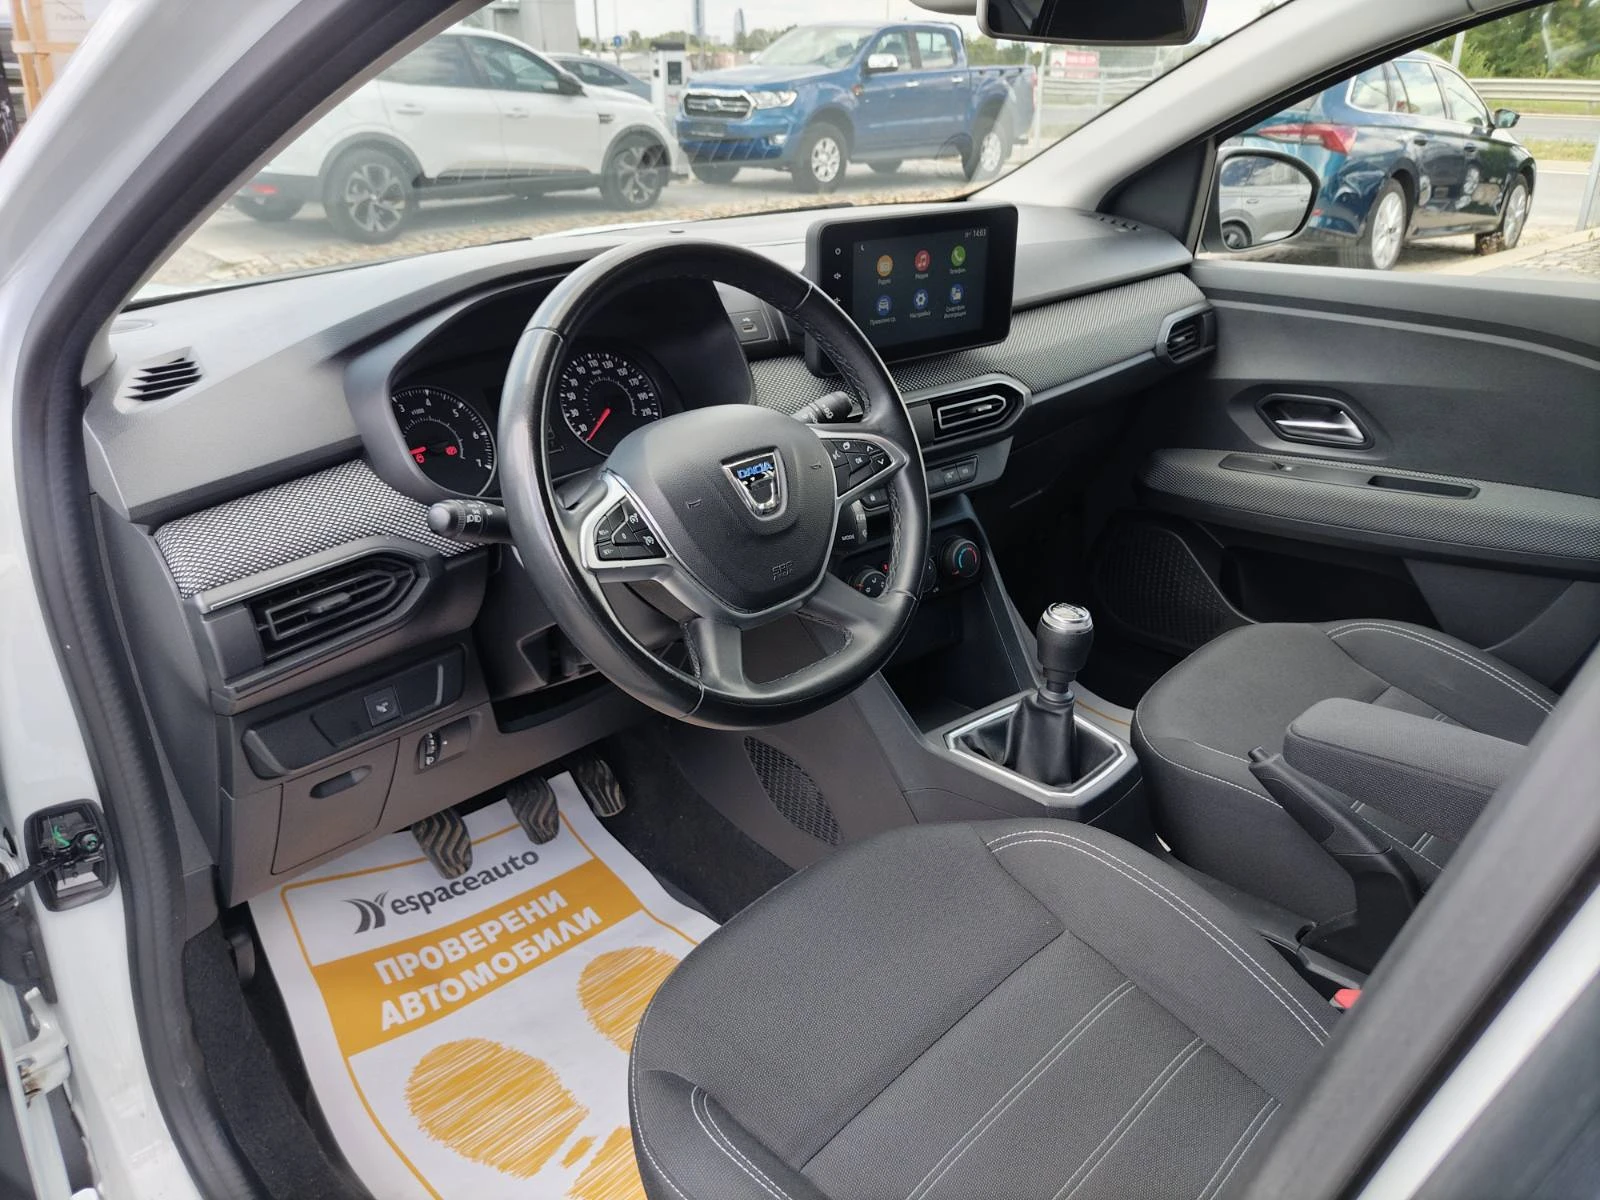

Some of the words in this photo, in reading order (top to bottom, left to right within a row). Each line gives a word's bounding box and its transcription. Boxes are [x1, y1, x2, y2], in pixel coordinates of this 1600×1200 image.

[576, 366, 586, 375] 90
[425, 398, 432, 407] 4
[398, 404, 405, 413] 3
[452, 408, 459, 418] 5
[472, 431, 479, 440] 6
[475, 458, 482, 468] 7
[736, 461, 773, 479] DACIA
[391, 849, 539, 917] espaceauto
[374, 889, 568, 985] ПРОВЕРЕНИ
[380, 906, 602, 1031] АВТОМОБИЛИ
